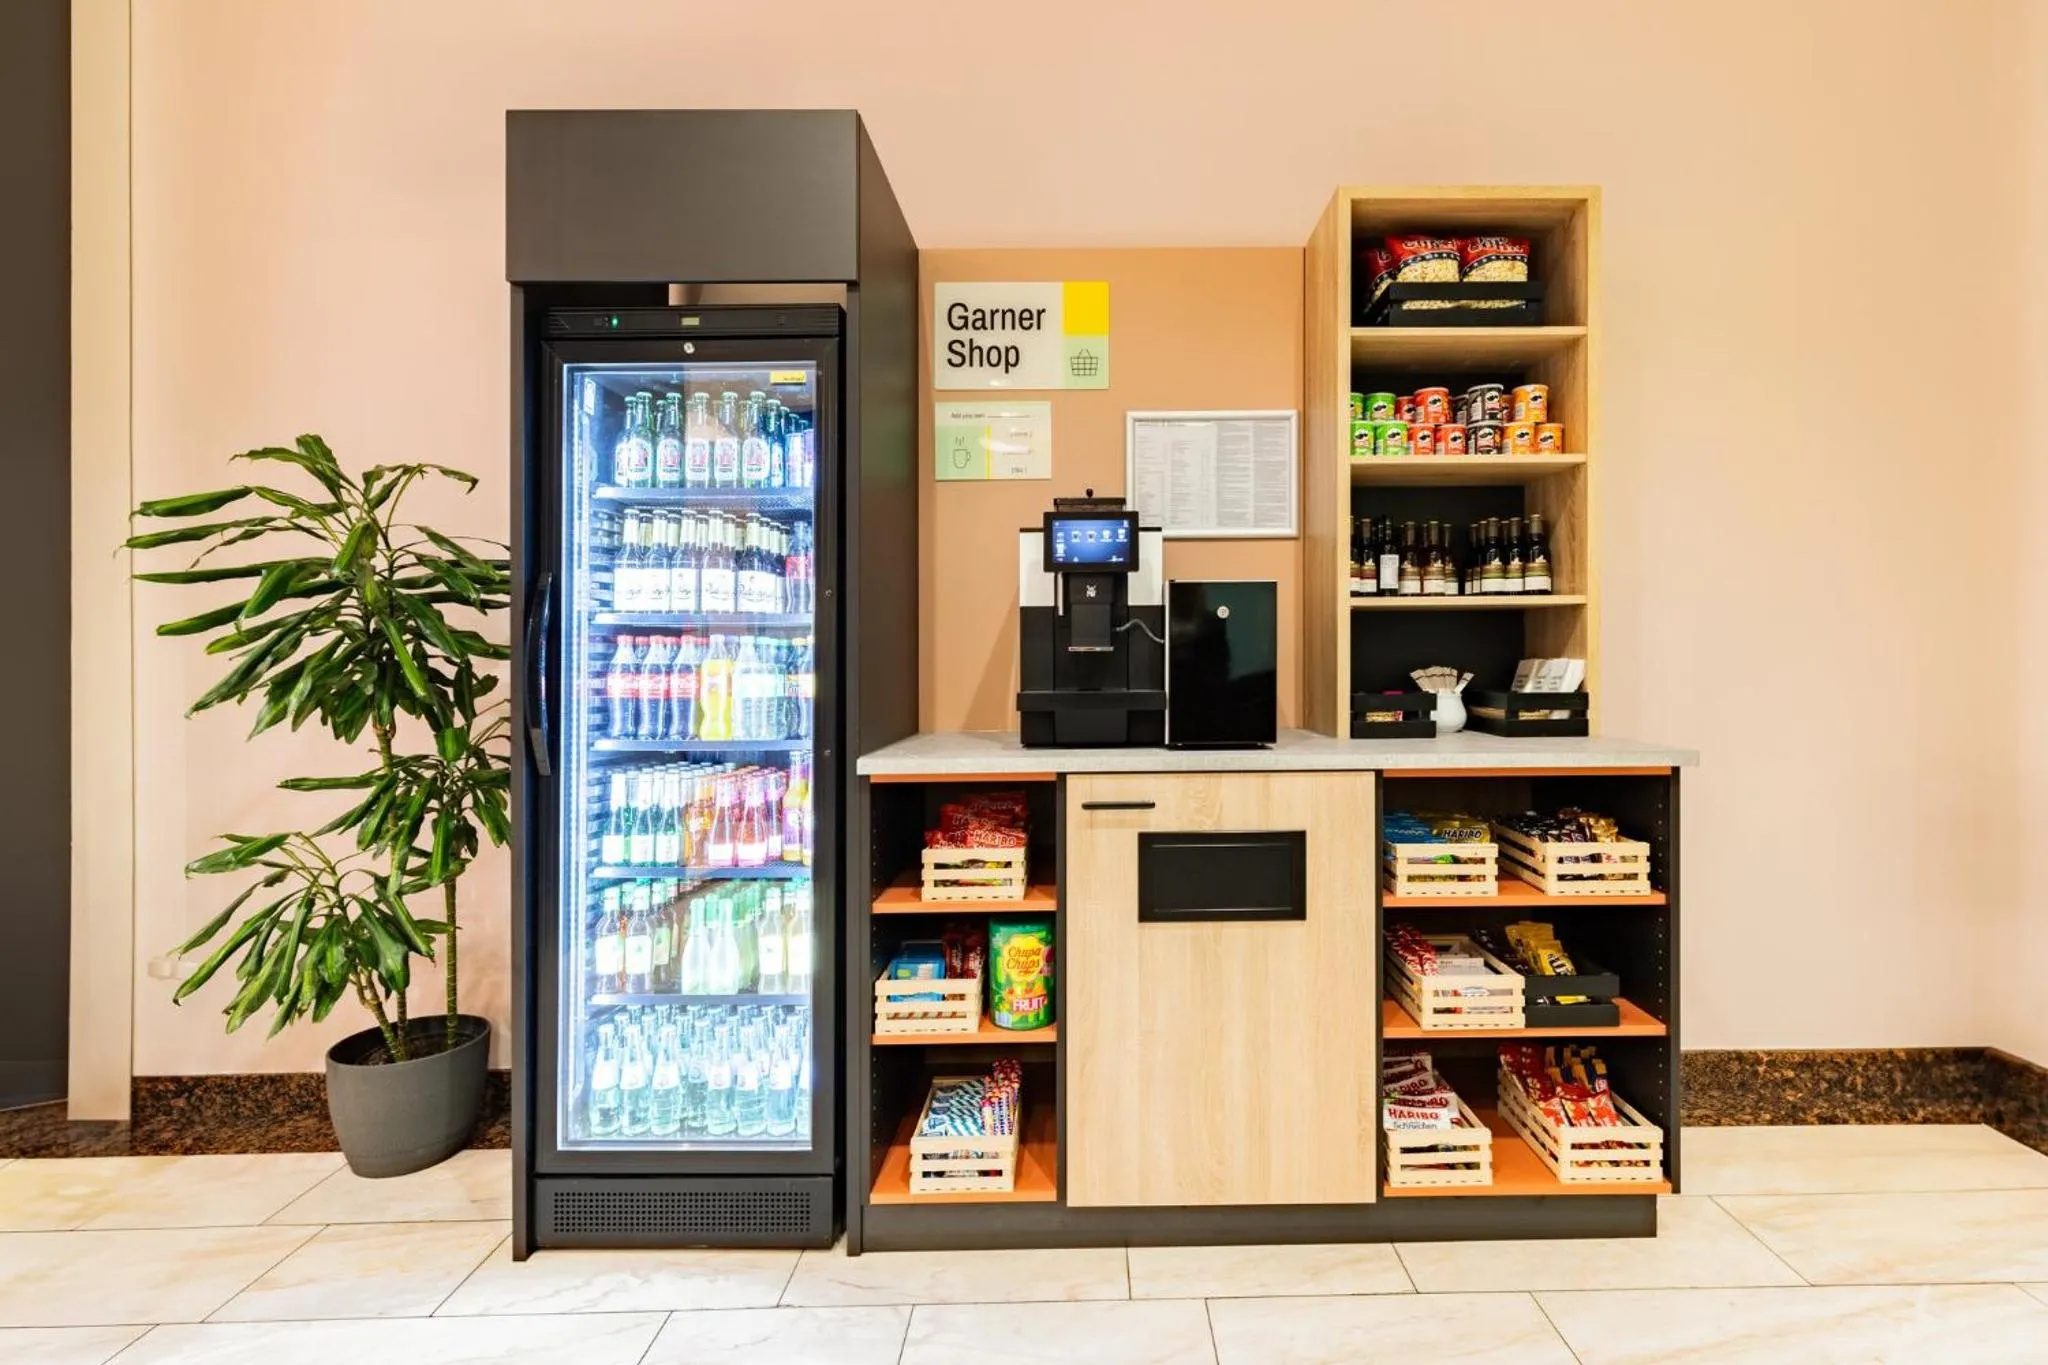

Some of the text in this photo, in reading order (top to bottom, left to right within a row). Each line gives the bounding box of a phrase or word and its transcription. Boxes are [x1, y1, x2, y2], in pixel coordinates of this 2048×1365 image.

[946, 302, 1046, 331] Garner
[946, 338, 1020, 374] Shop
[974, 830, 1017, 846] HARIBO
[1442, 828, 1483, 840] HARIBO
[1008, 946, 1042, 960] Chupa
[1006, 957, 1040, 970] Chups
[1013, 995, 1046, 1012] FRUIT
[1388, 1107, 1440, 1119] HARIBO
